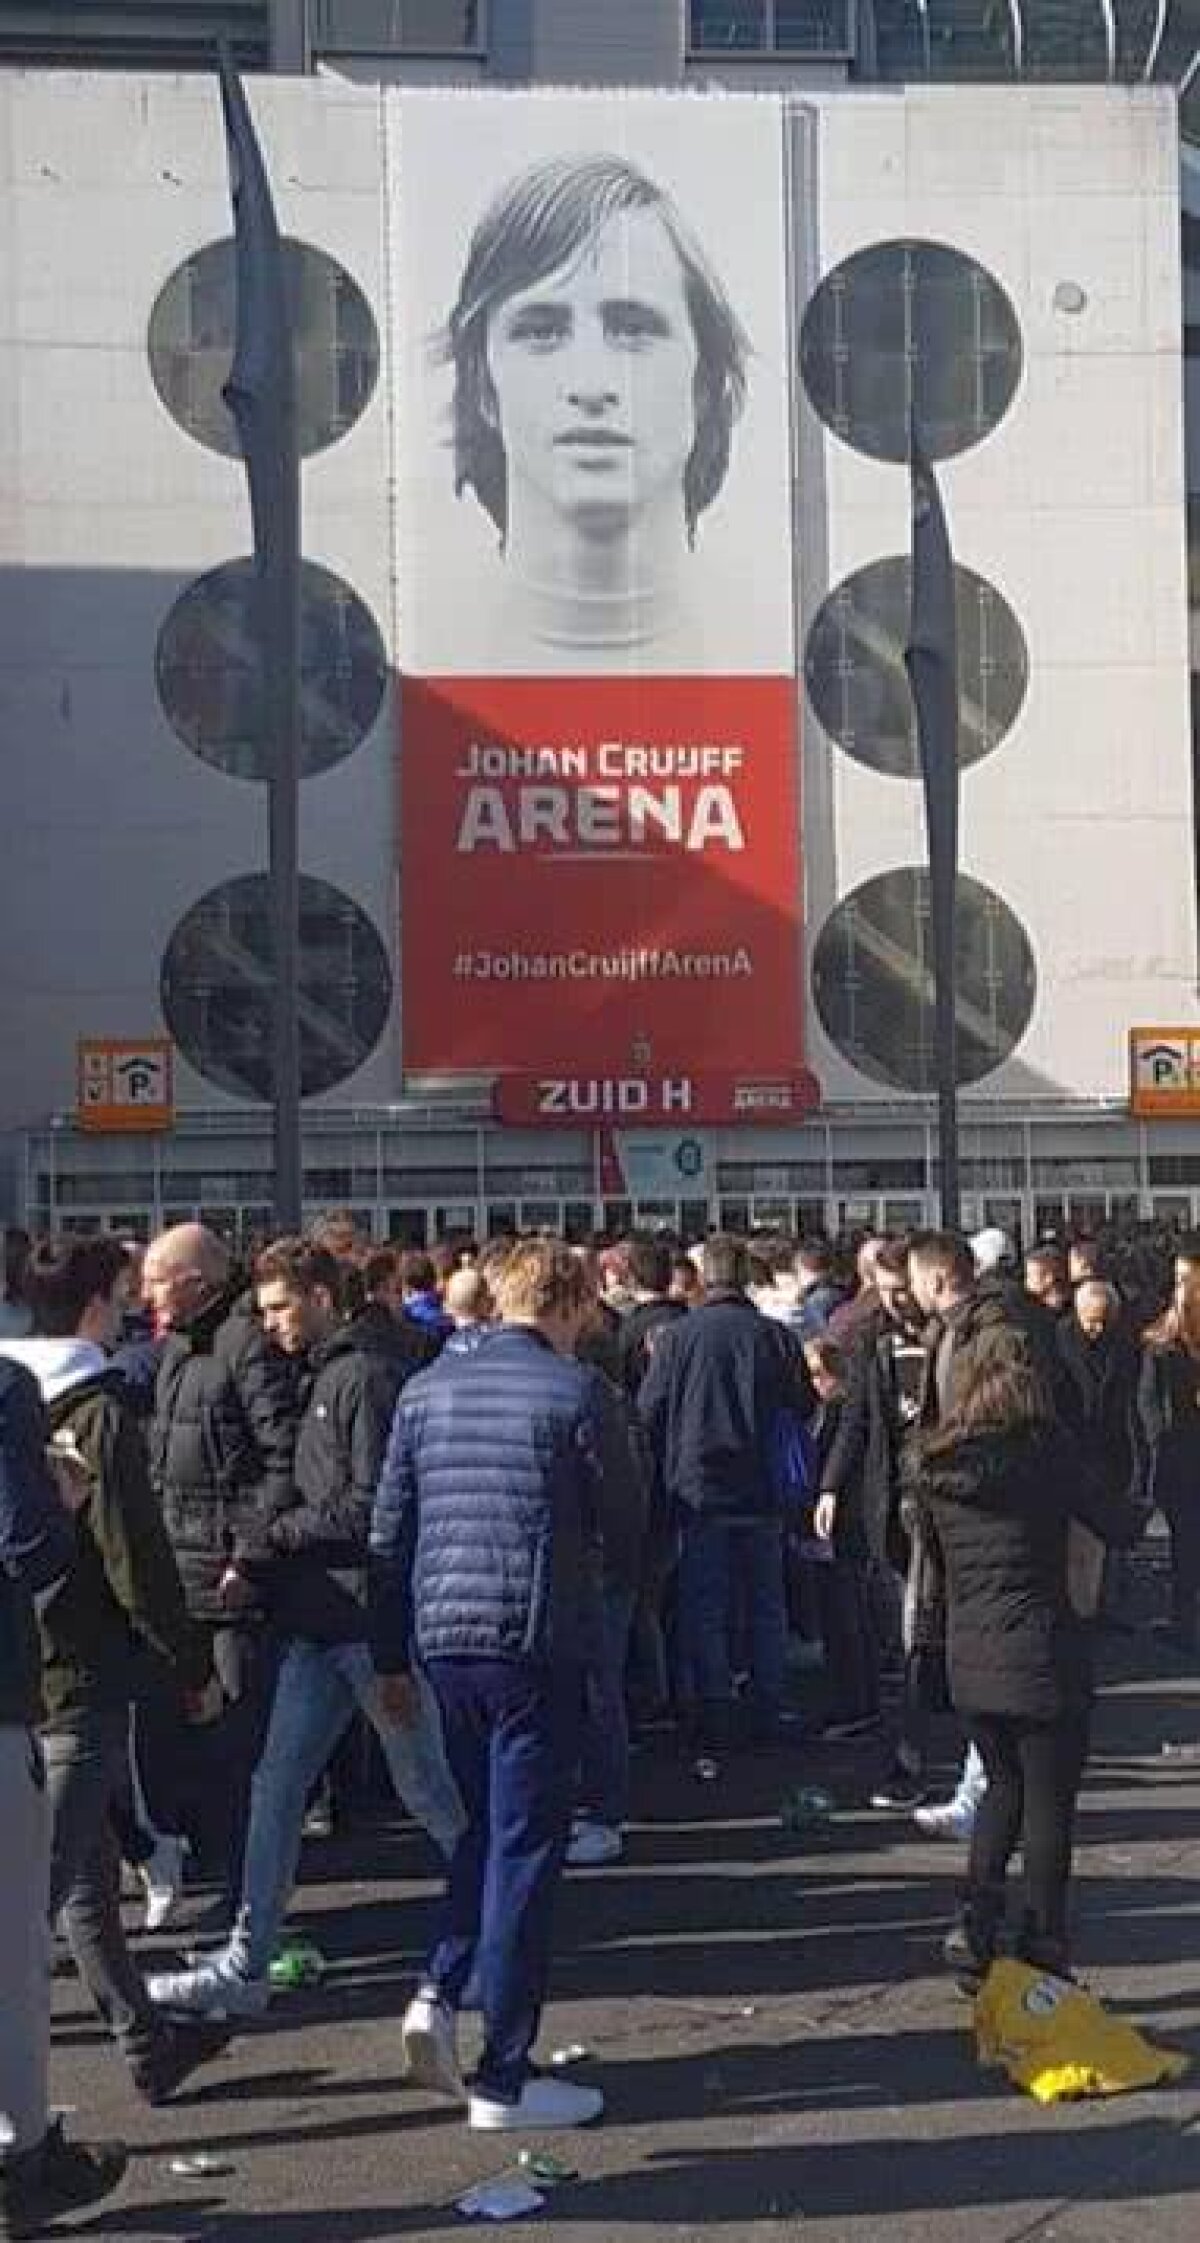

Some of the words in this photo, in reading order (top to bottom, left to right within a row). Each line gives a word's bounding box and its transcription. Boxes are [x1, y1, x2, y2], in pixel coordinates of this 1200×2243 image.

[454, 744, 587, 777] JOHAN
[457, 784, 746, 851] ARENA
[538, 1079, 647, 1112] ZUID
[662, 1079, 692, 1111] H
